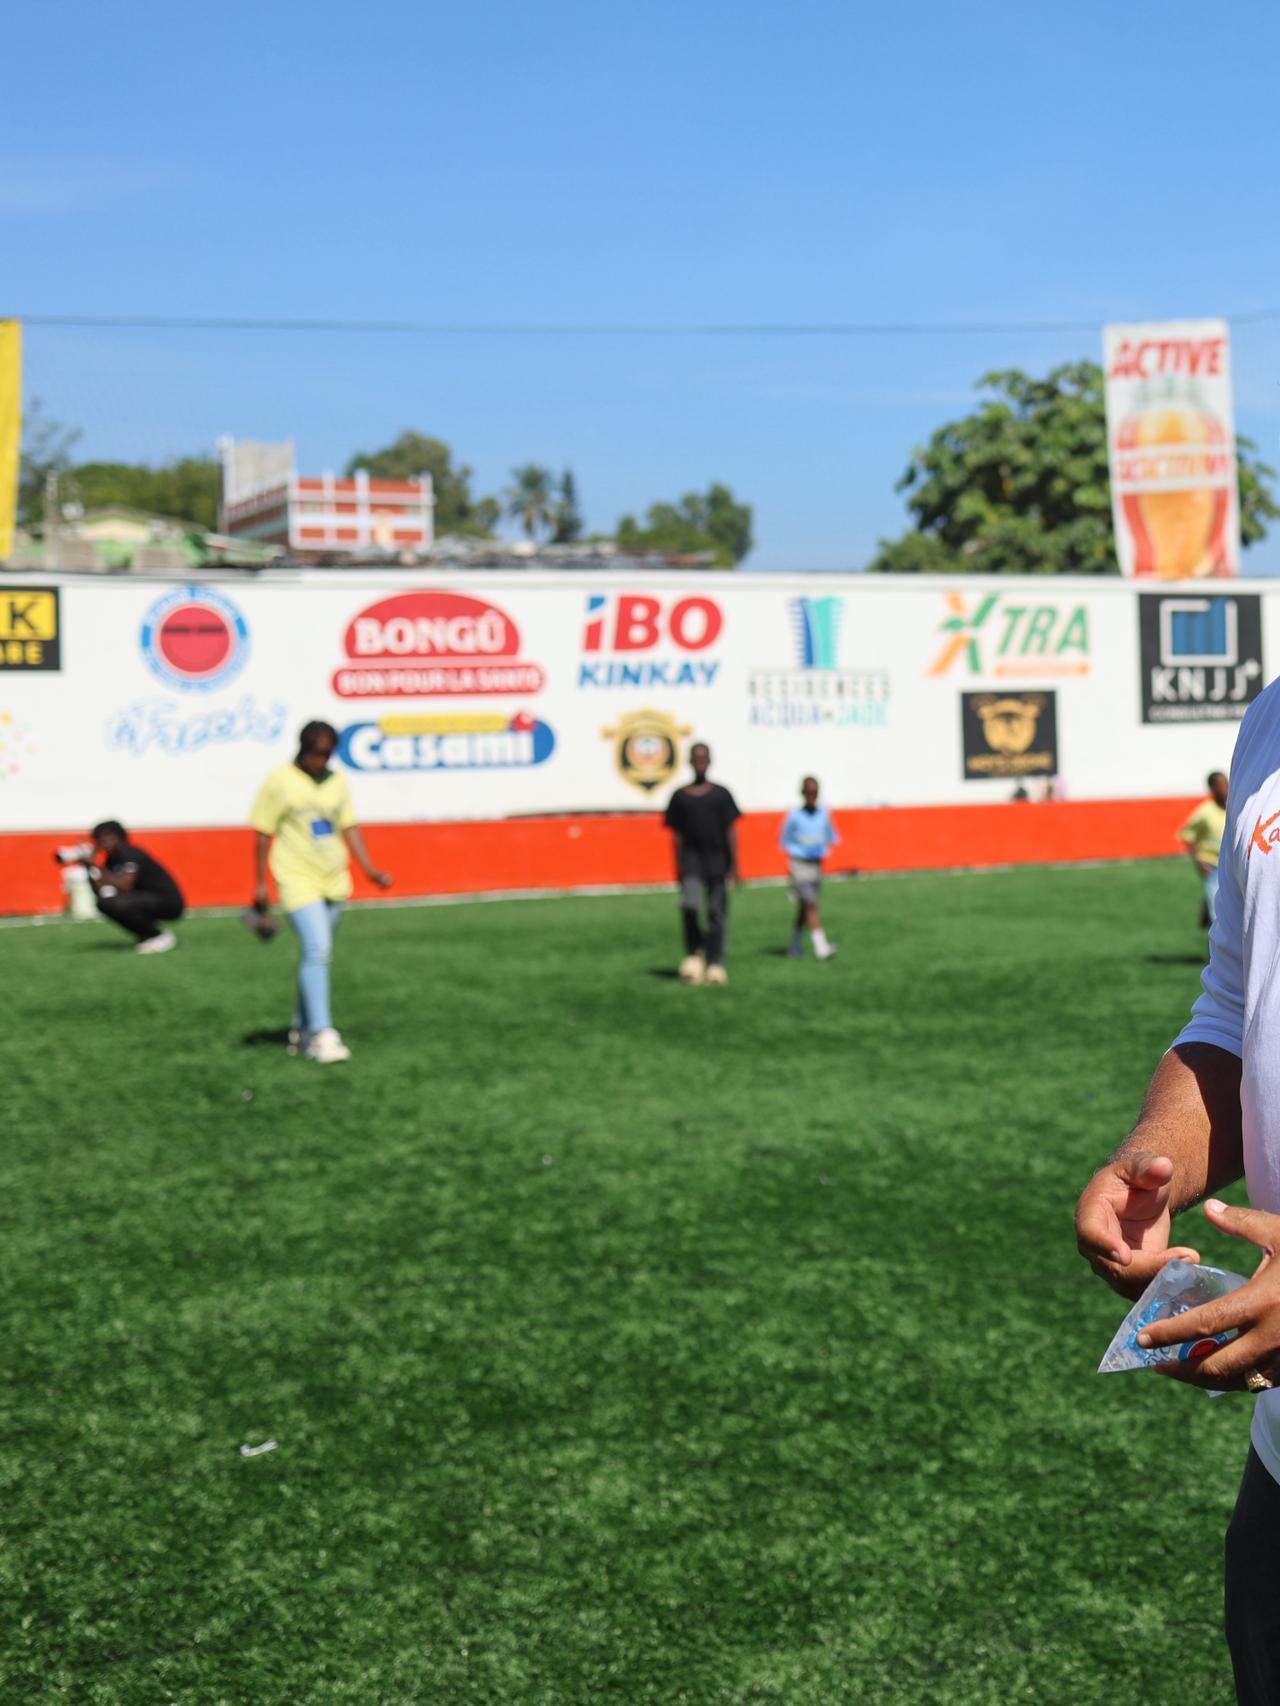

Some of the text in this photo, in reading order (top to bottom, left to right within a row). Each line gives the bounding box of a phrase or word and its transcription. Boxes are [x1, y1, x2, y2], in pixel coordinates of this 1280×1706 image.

[1110, 336, 1225, 378] ACTIVE
[931, 590, 1087, 676] XTRA
[339, 670, 385, 694] BON
[386, 668, 445, 692] POUR
[448, 667, 474, 691] LA
[578, 661, 720, 689] KINKAY
[348, 718, 535, 769] Casami
